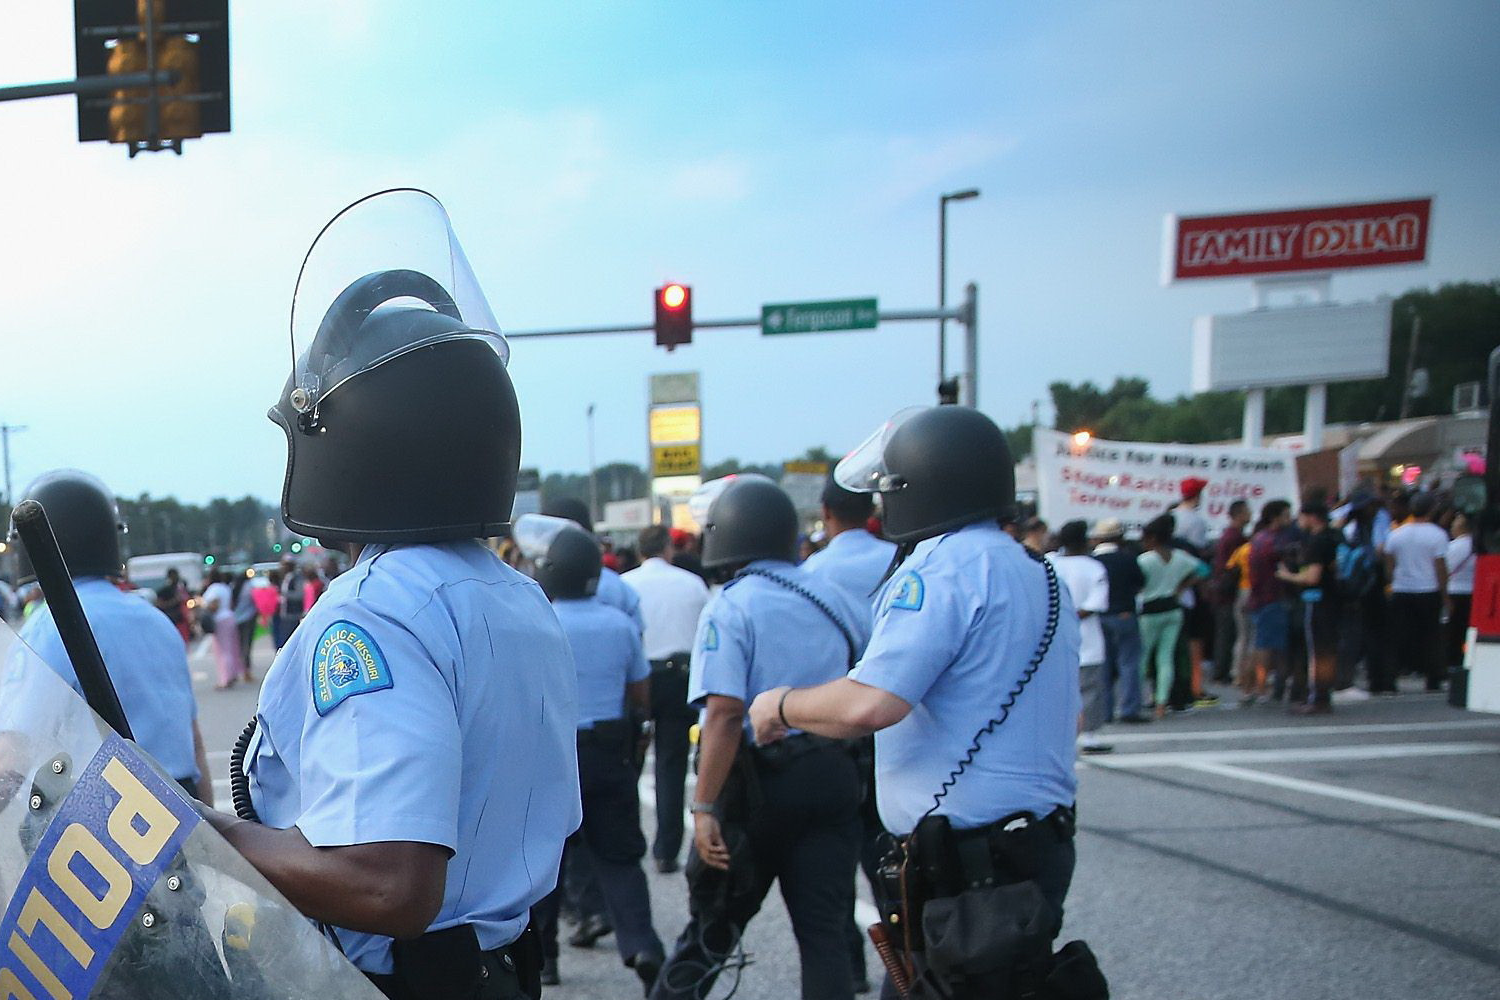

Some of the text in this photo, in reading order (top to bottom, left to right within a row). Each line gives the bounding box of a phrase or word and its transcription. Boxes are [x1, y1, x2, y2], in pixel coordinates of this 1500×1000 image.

[1182, 214, 1419, 267] FAMILY DOLLAR
[1217, 455, 1284, 473] Brown
[1119, 472, 1180, 493] Racis
[1207, 479, 1264, 498] olice
[321, 629, 357, 656] POLICE
[353, 639, 380, 681] MISSOURI
